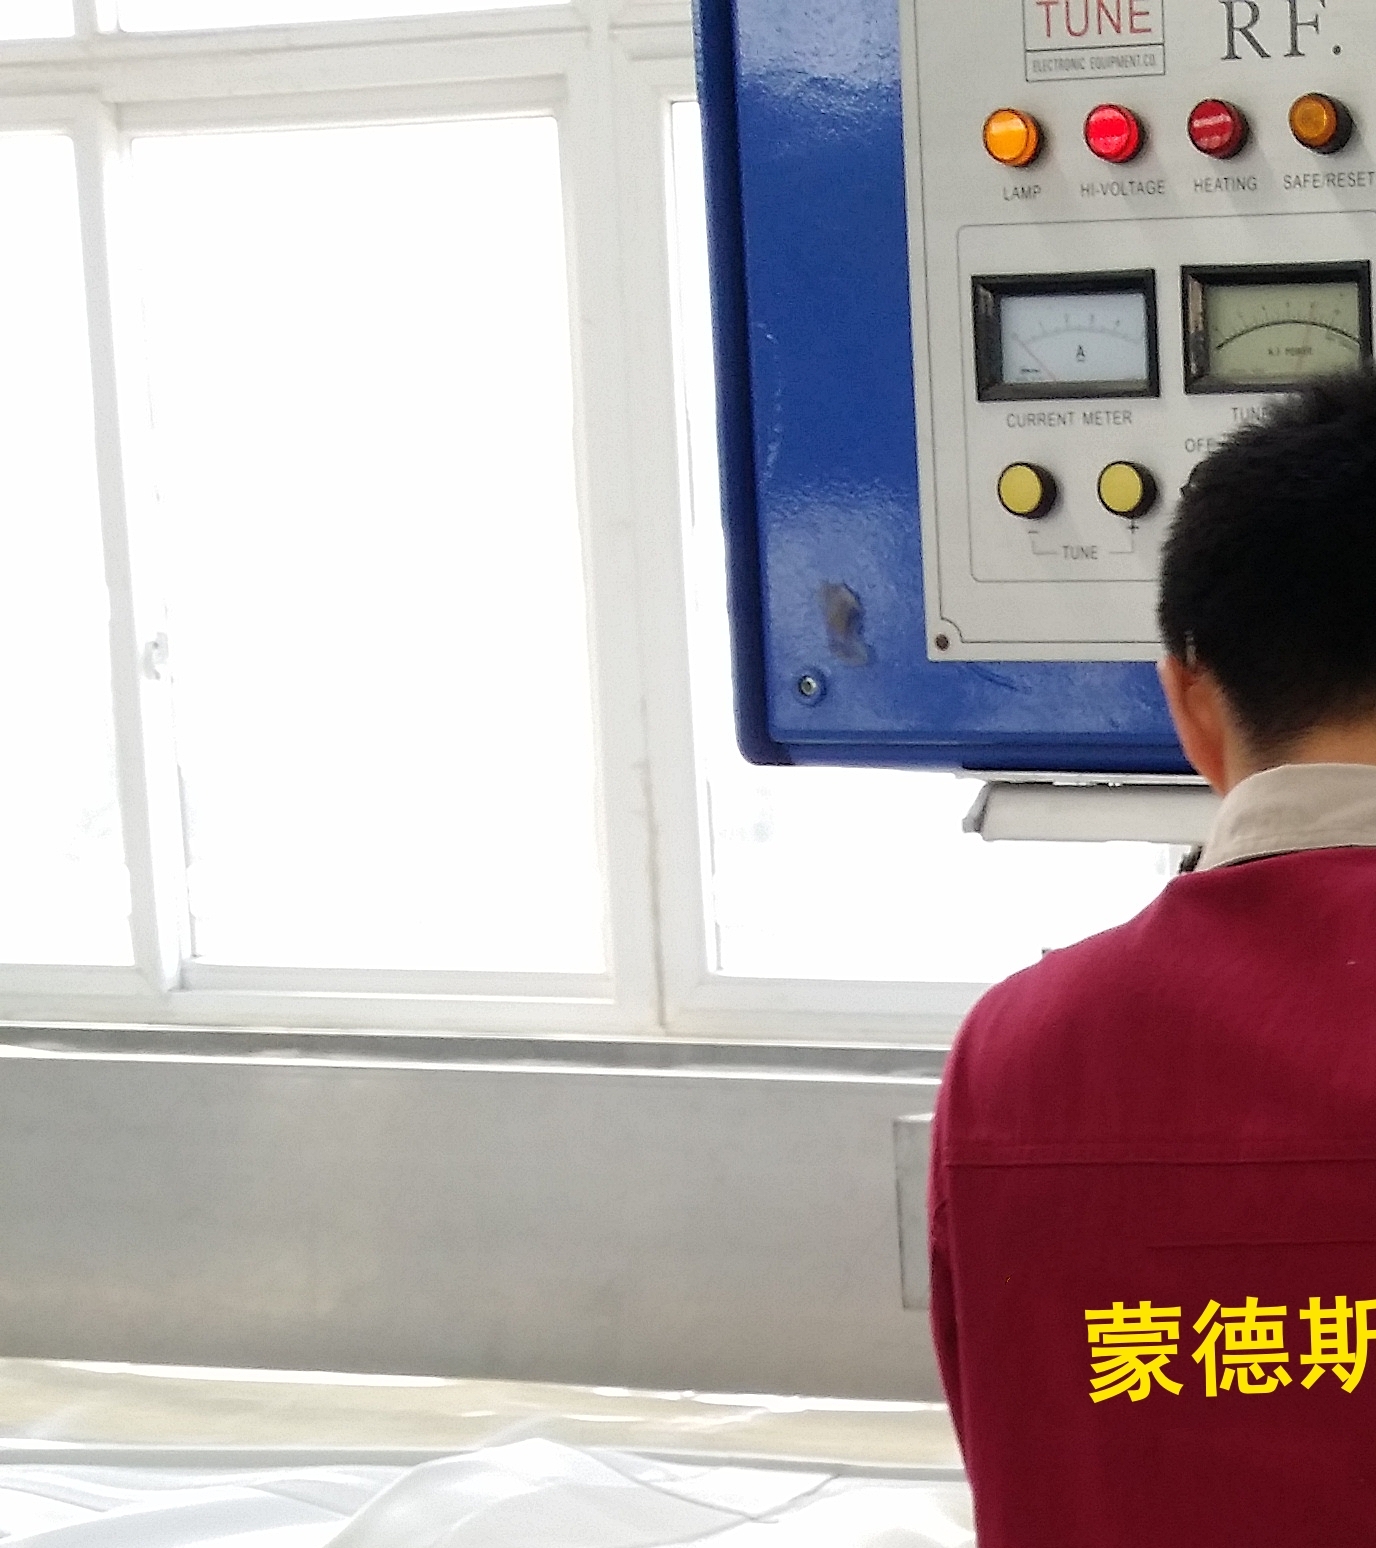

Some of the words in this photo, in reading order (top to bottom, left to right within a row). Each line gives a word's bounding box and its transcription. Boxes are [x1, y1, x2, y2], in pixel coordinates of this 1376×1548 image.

[1035, 0, 1152, 37] TUNE
[1003, 185, 1042, 201] LAMP
[1080, 179, 1166, 197] HI-VOLTAGE
[1193, 175, 1258, 193] HEATING
[1006, 412, 1074, 428] CURRENT
[1082, 409, 1133, 426] METER
[1062, 545, 1099, 560] TUNE
